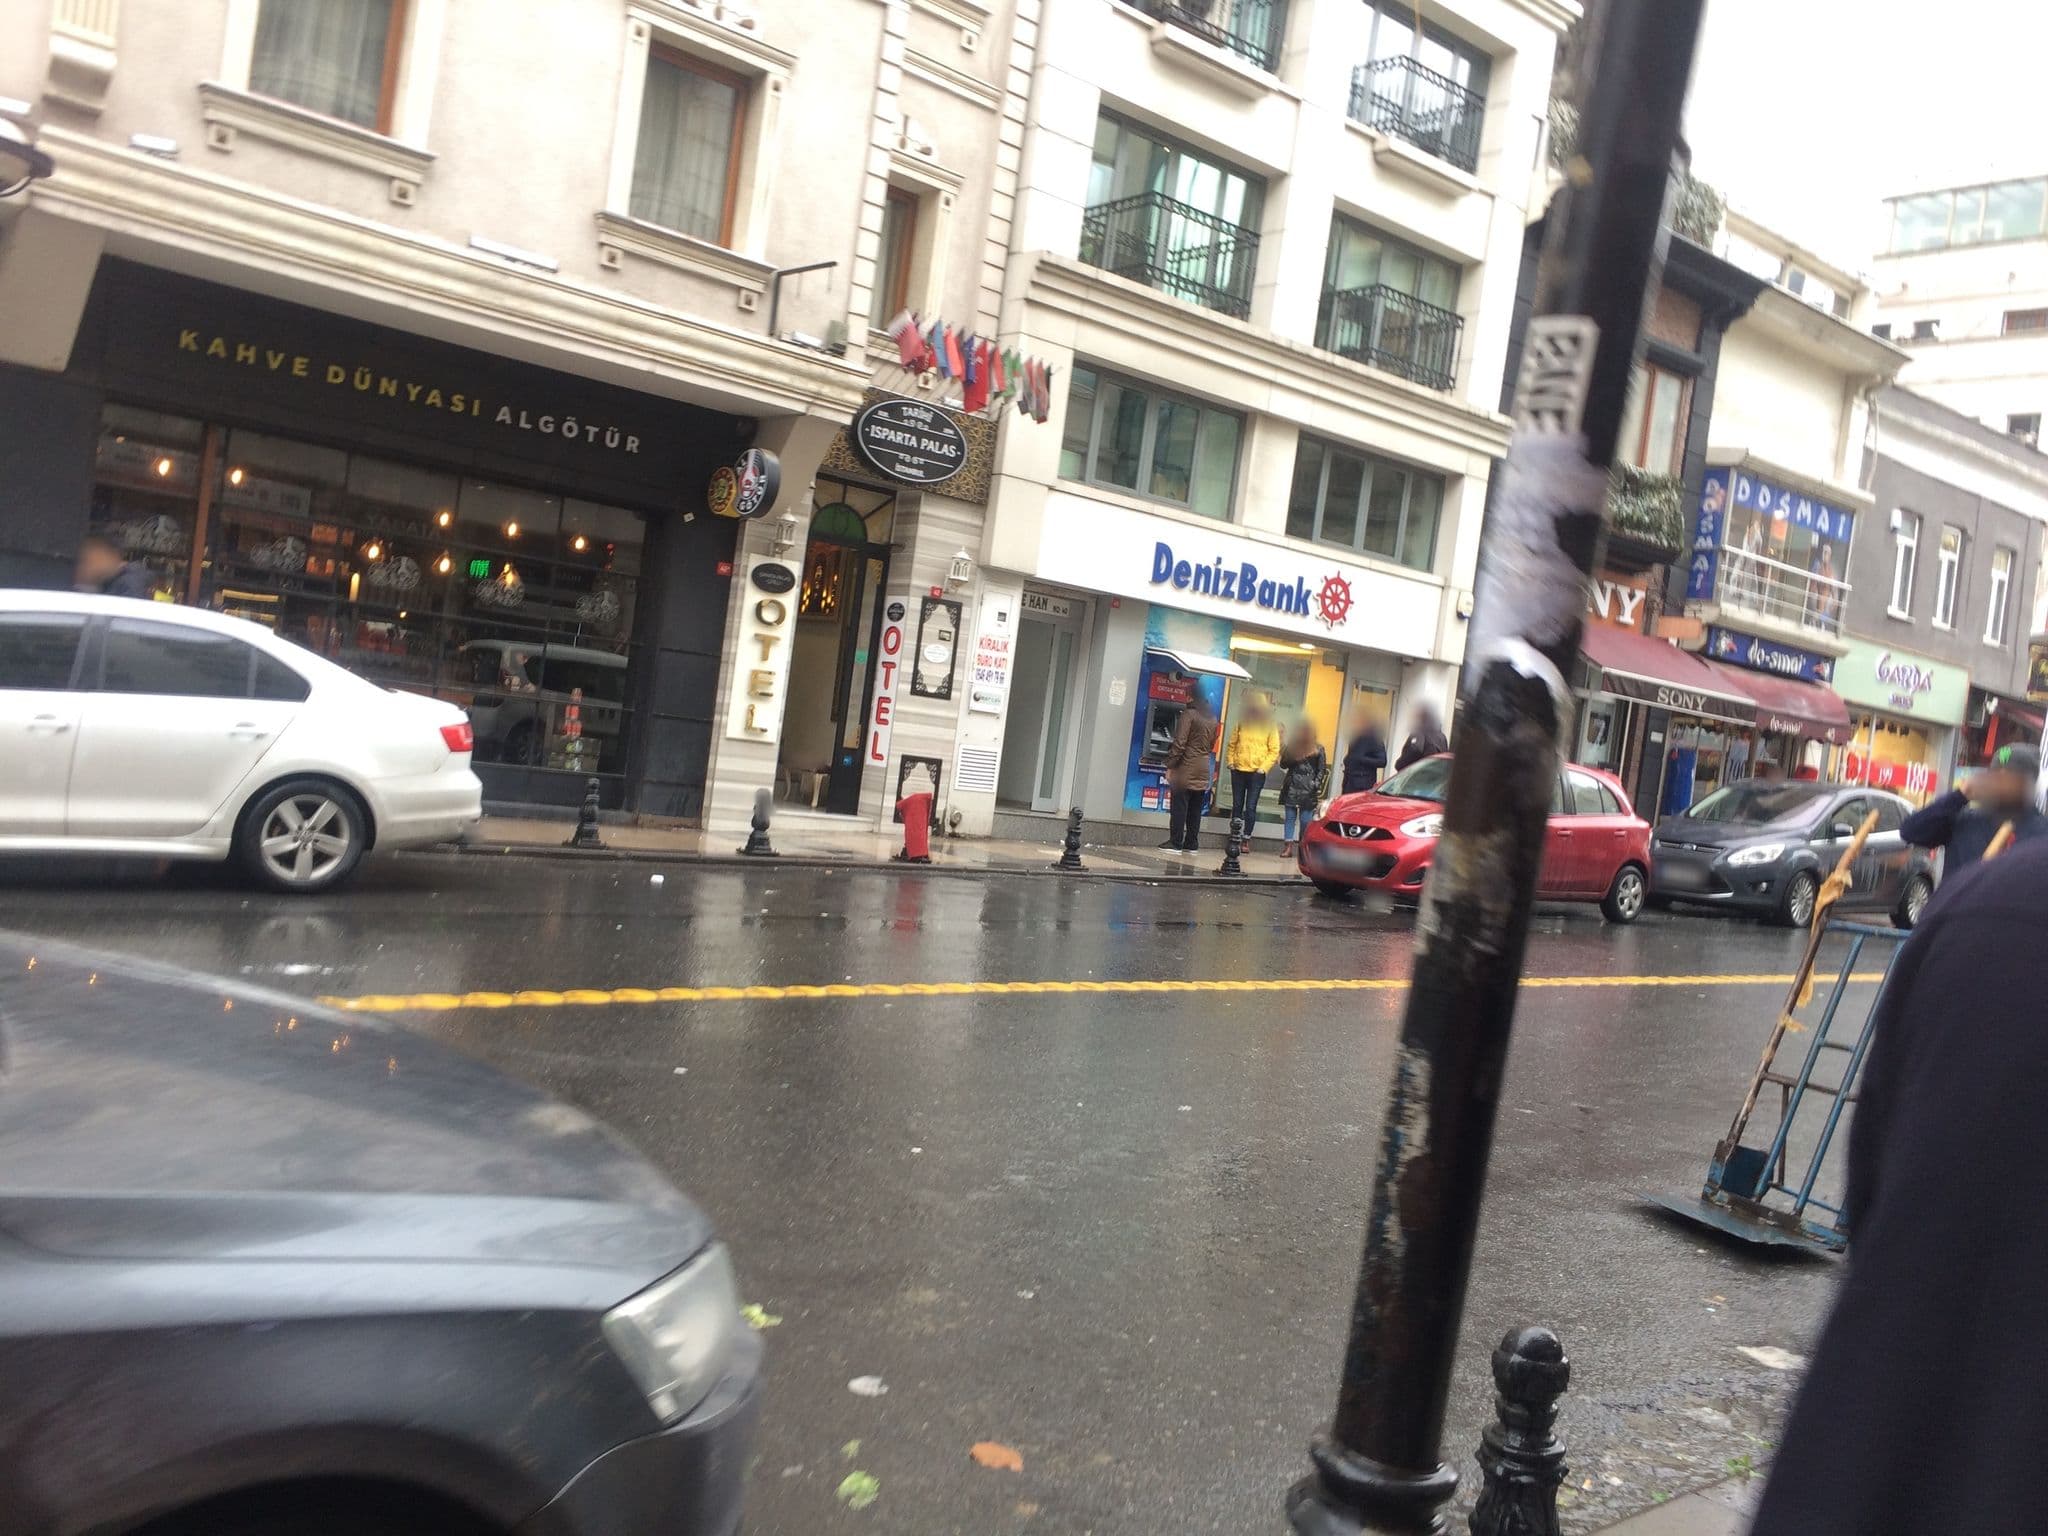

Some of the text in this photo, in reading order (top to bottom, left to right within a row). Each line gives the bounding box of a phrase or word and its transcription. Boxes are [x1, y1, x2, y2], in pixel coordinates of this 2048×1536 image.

[179, 329, 640, 454] KAHVE DÜNYASI ALGÖTÜR
[869, 424, 918, 448] ISPARTA
[920, 438, 957, 458] PALAS
[1029, 595, 1048, 610] HAN
[1151, 541, 1313, 617] DenizBank
[744, 598, 787, 735] OTEL
[870, 625, 901, 761] OTEL
[1656, 685, 1708, 712] SONY
[1905, 760, 1929, 795] 189
